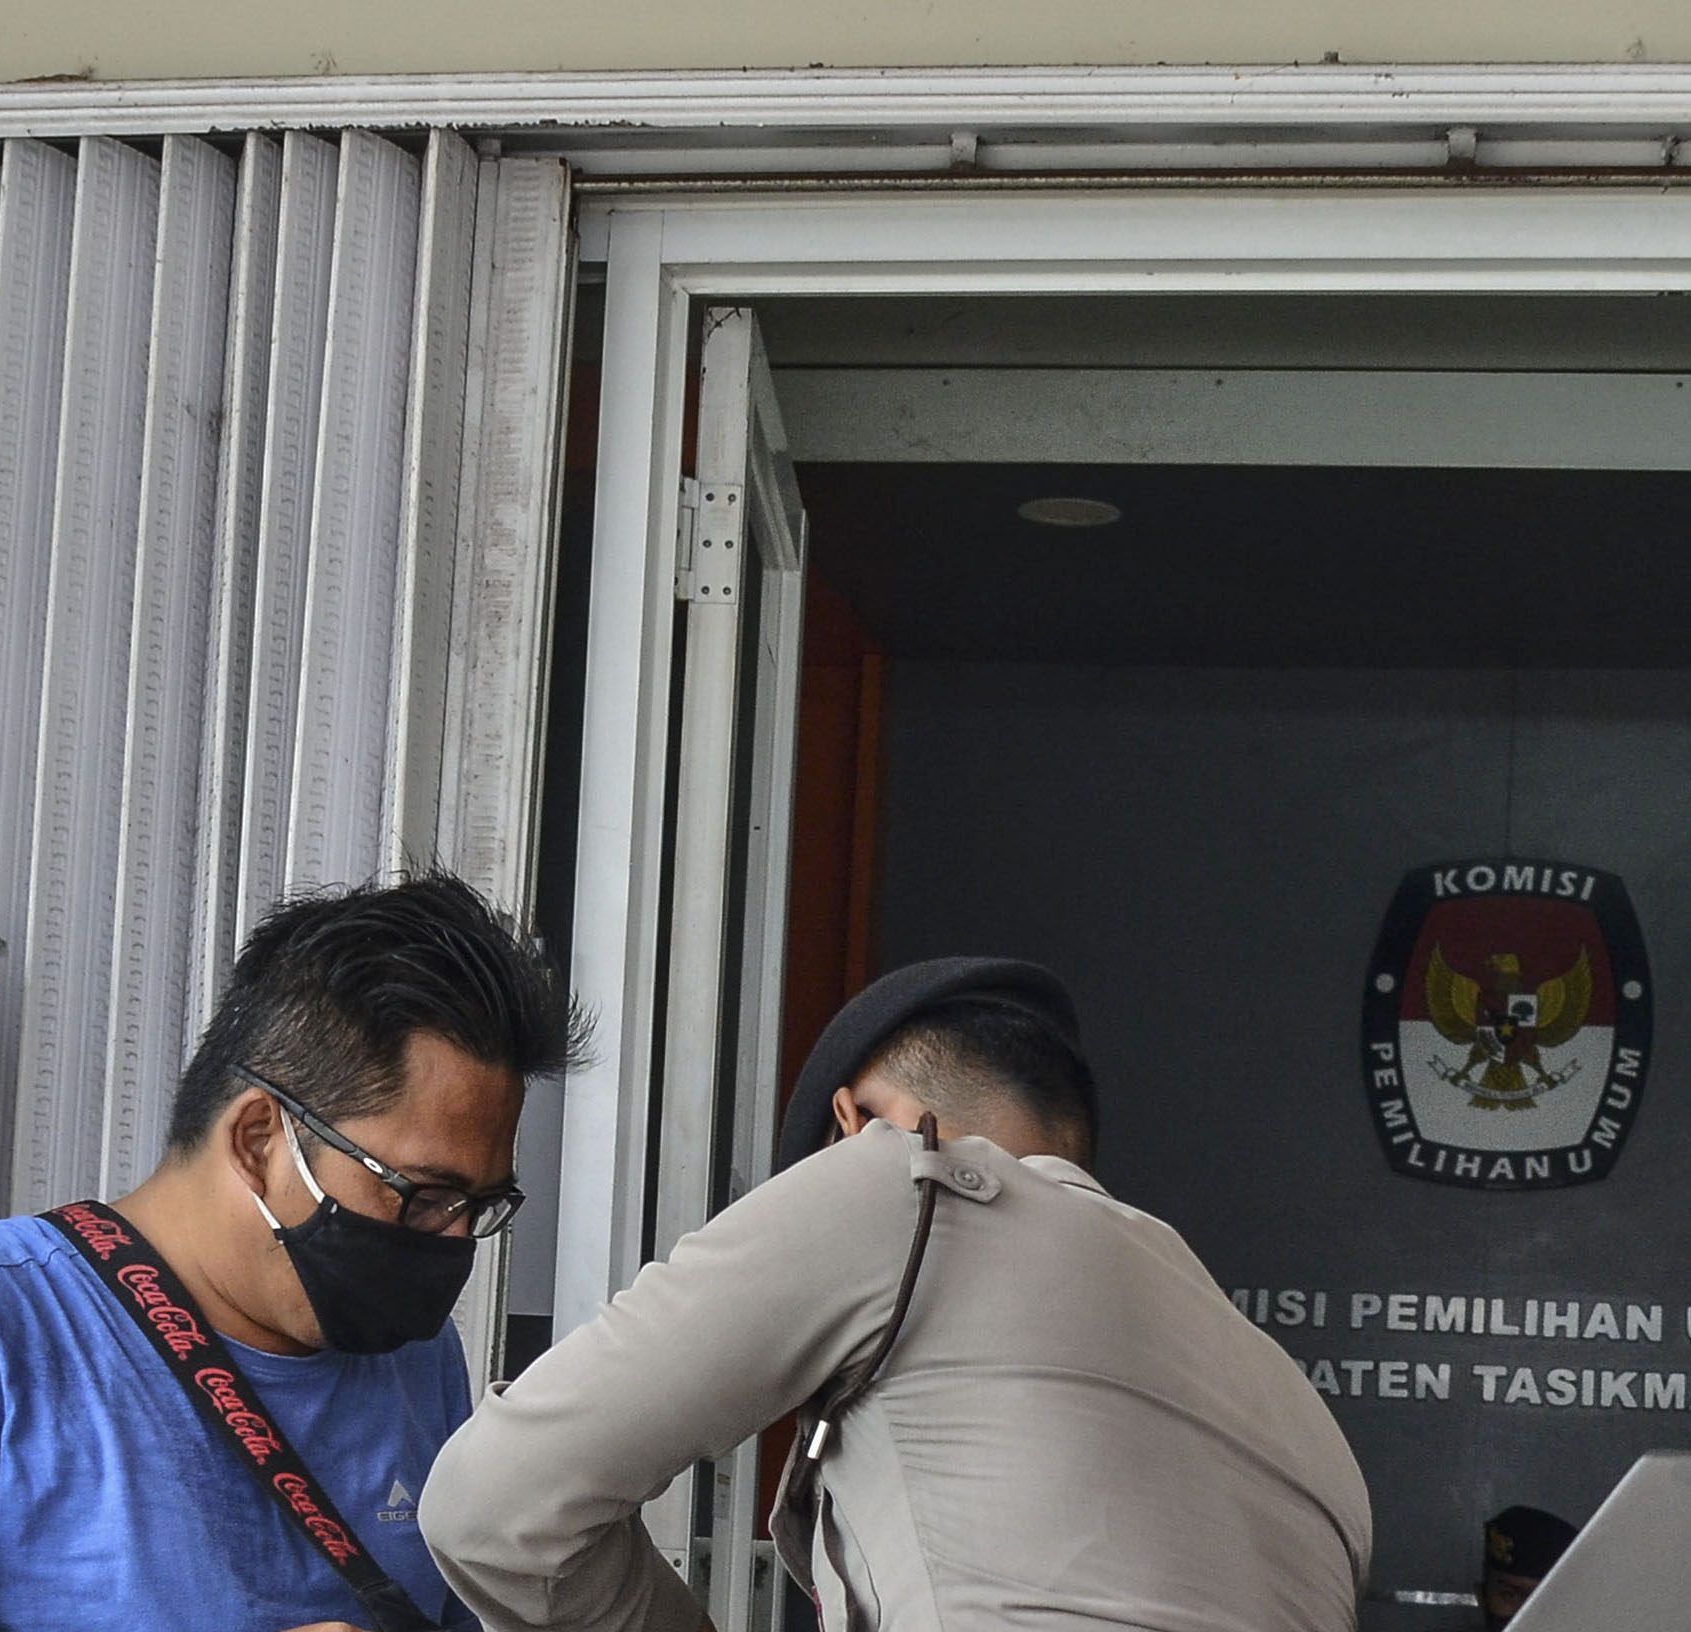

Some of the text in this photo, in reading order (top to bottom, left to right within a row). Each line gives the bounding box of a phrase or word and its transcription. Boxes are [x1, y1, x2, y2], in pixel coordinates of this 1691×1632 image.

[1434, 865, 1595, 900] KOMISI
[1370, 1042, 1641, 1180] PEMILIHAN UMUM
[1350, 1293, 1662, 1342] PEMILIHAN
[1292, 1358, 1691, 1410] ATEN TASIKM
